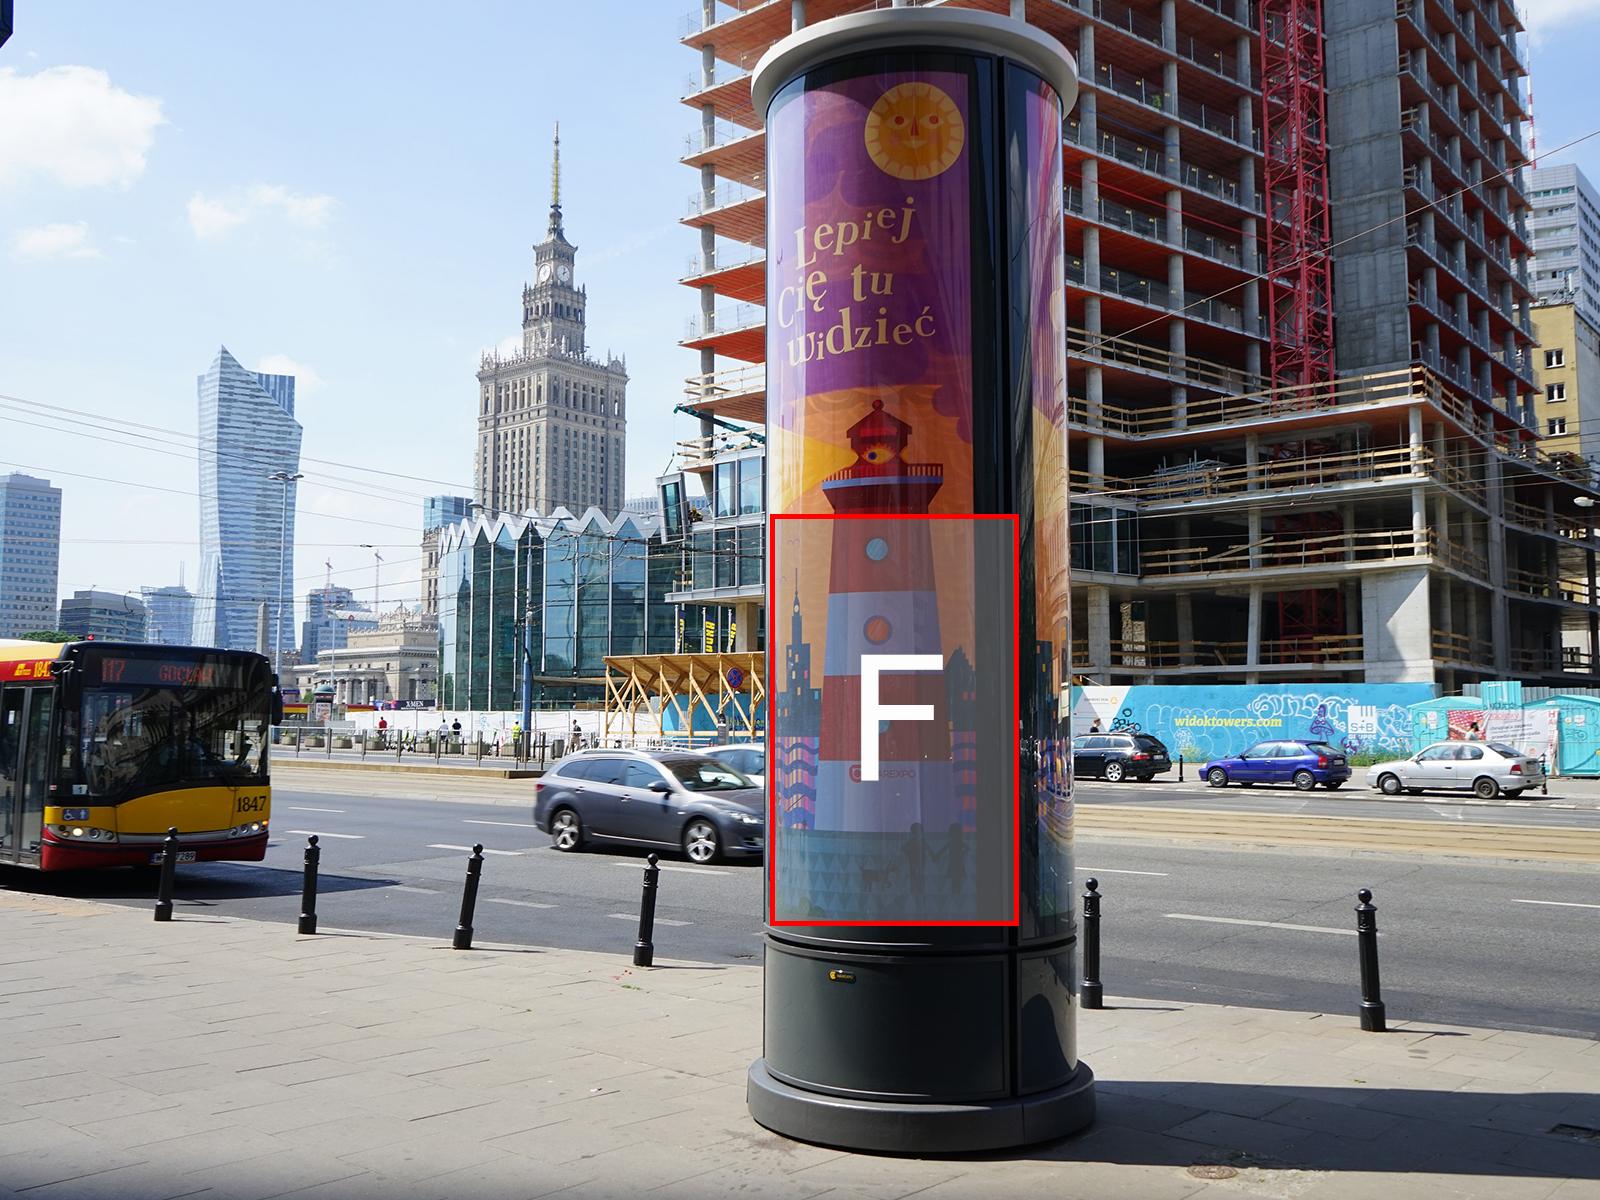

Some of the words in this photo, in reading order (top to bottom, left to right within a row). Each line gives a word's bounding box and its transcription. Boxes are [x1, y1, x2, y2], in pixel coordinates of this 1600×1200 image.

[794, 196, 916, 271] Lepiej
[777, 270, 827, 329] Cię
[851, 263, 893, 302] tu
[786, 306, 936, 367] widzieć
[102, 658, 126, 683] 117
[1174, 715, 1282, 728] widoktowers.com
[236, 796, 267, 812] 1847
